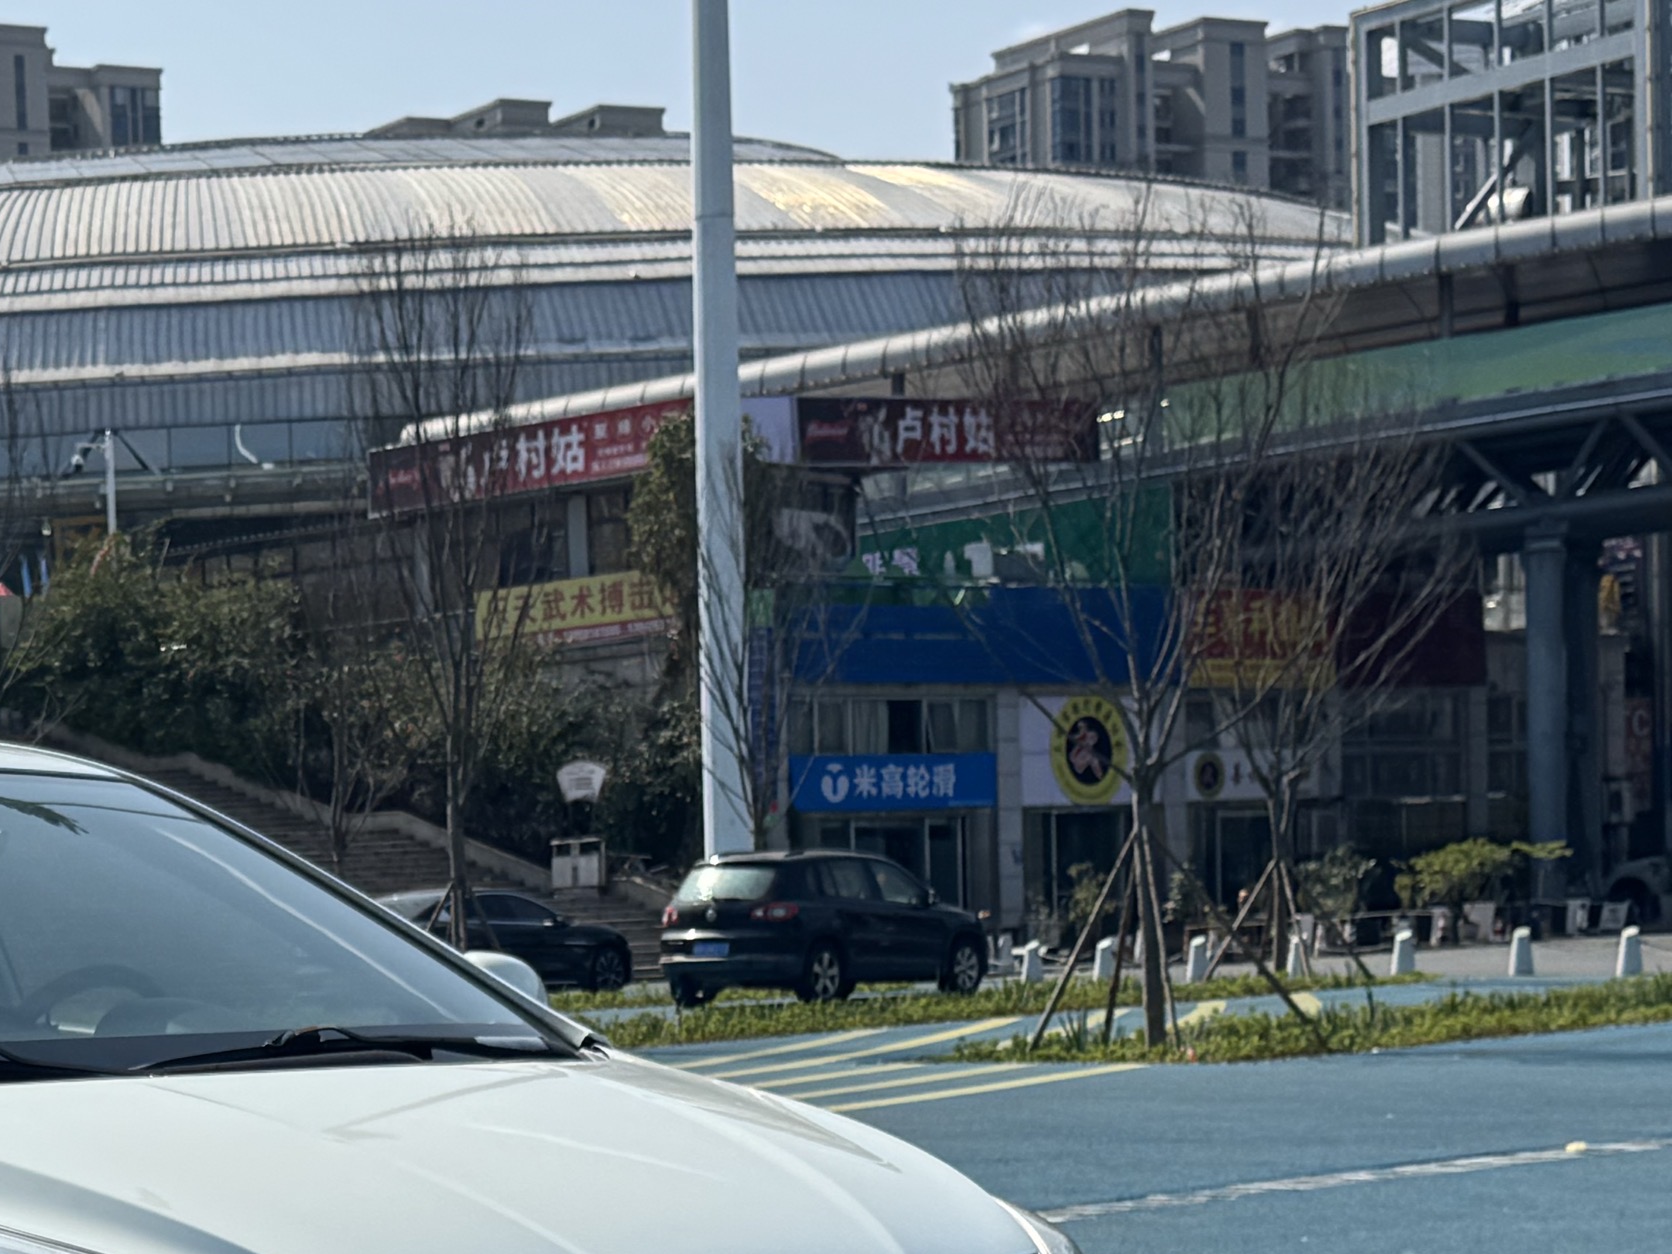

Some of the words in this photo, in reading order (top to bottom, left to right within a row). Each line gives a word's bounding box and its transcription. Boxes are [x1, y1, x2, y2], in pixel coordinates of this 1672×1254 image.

[897, 405, 996, 455] 卢村姑
[854, 763, 956, 799] 米高轮滑
